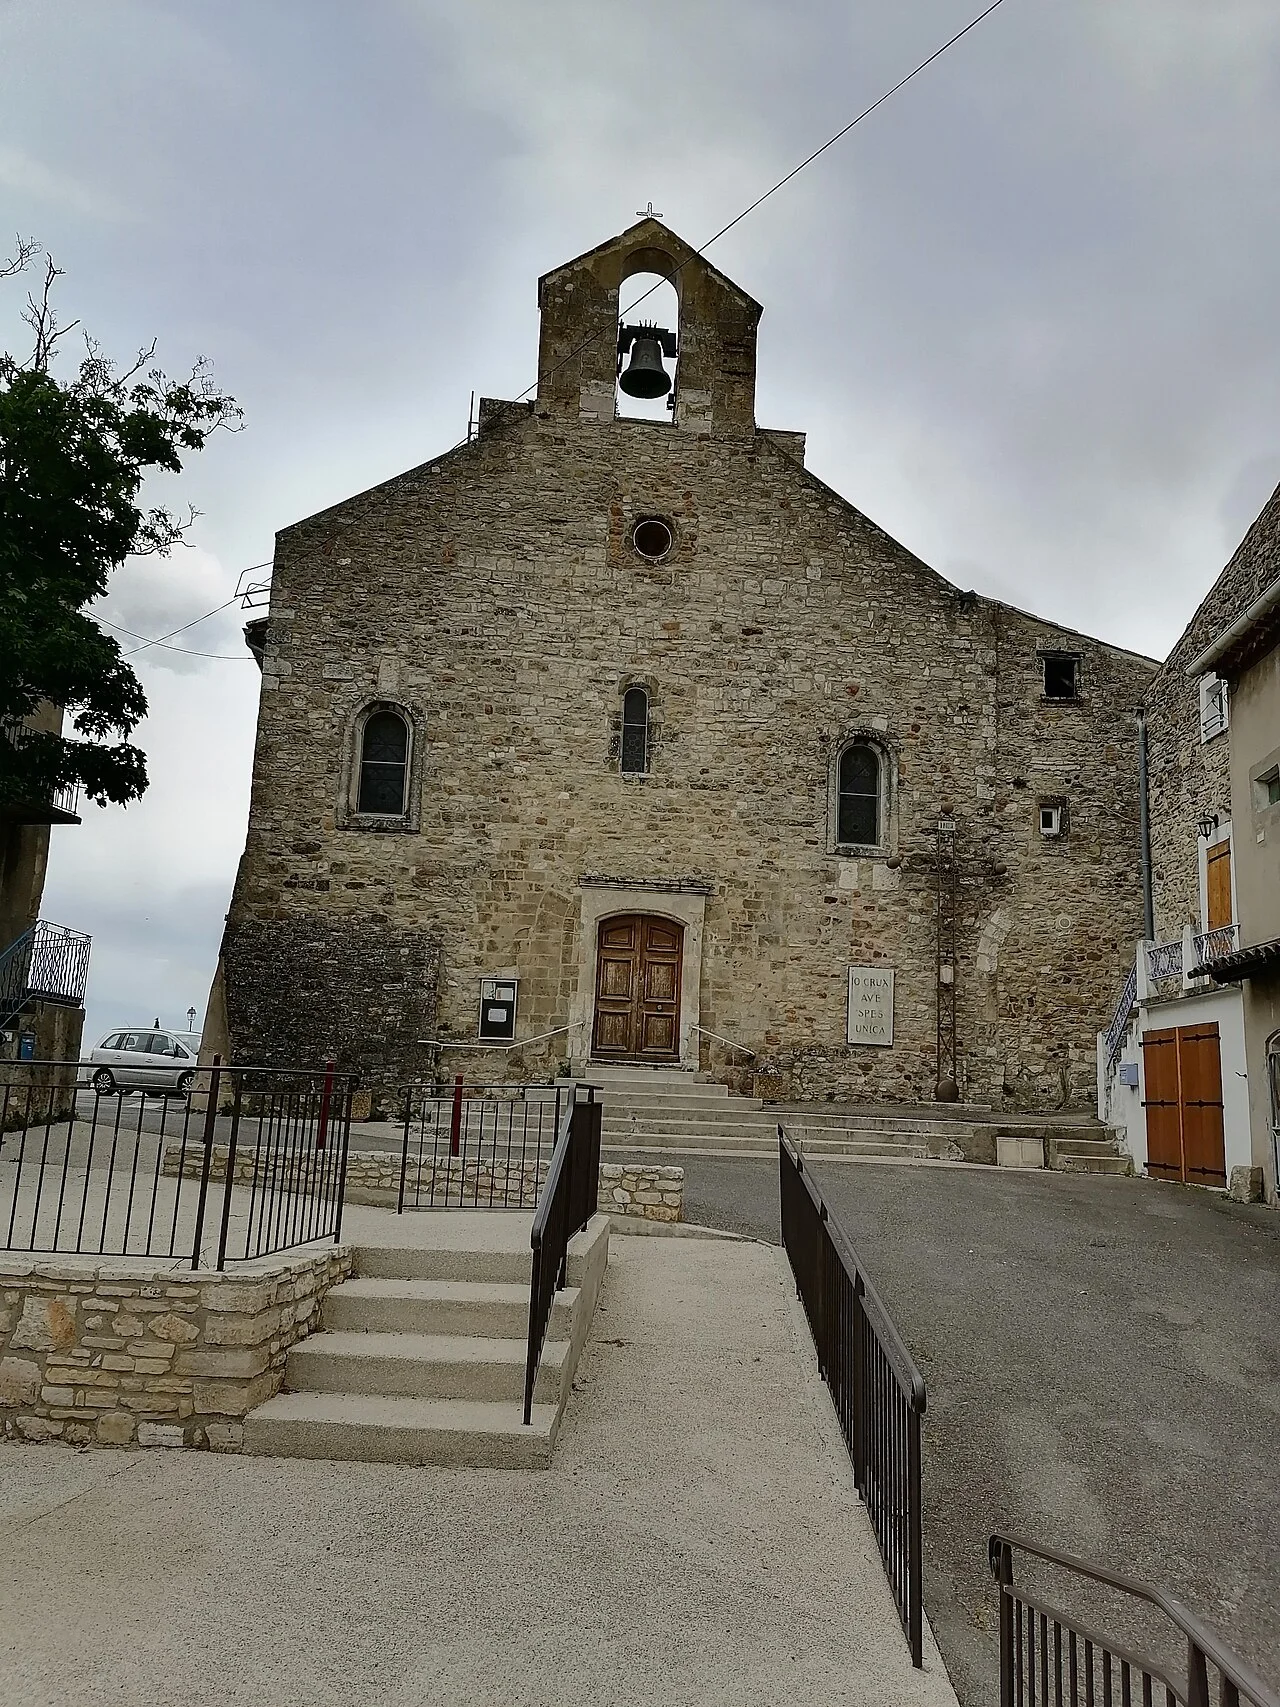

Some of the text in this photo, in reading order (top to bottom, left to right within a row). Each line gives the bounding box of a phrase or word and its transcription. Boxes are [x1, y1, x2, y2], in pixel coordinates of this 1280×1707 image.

[854, 977, 888, 987] O CRUX
[861, 994, 880, 1003] AVE
[858, 1010, 884, 1018] SPES
[856, 1024, 885, 1034] UNICA
